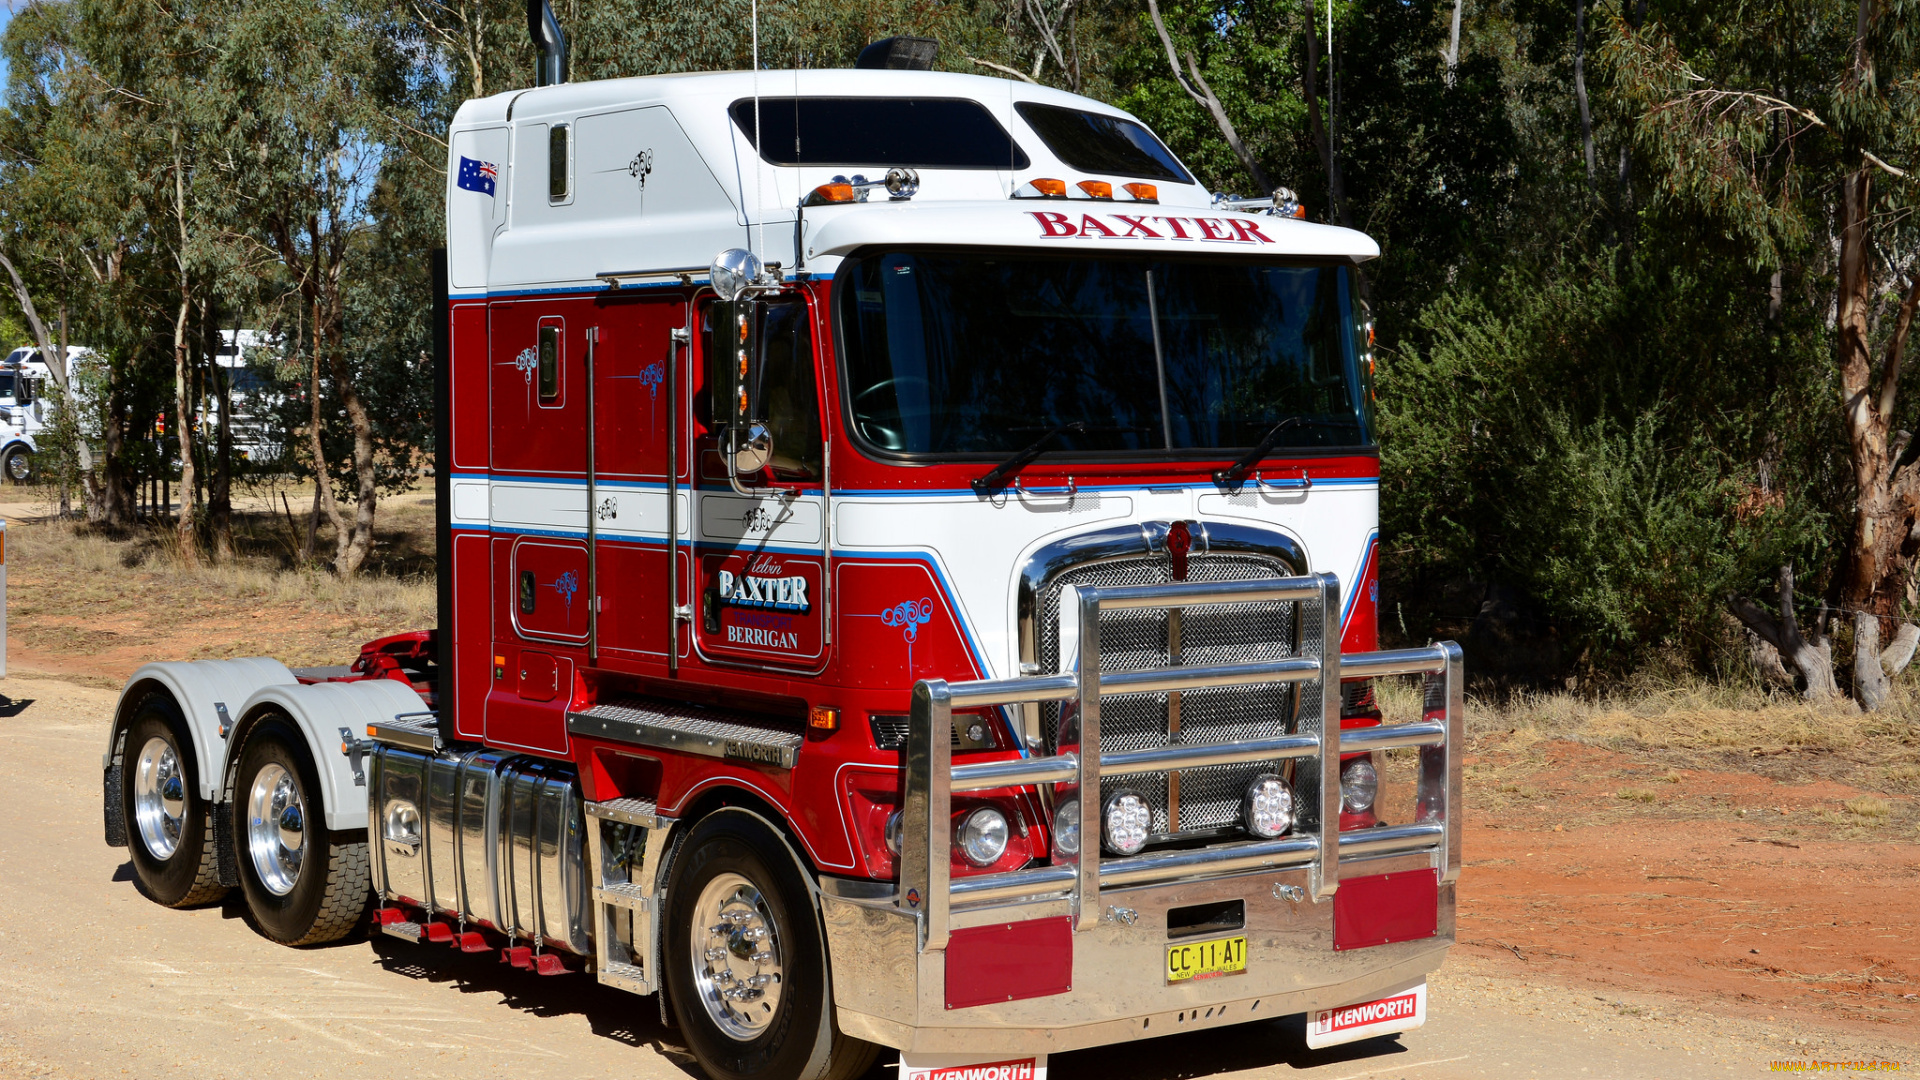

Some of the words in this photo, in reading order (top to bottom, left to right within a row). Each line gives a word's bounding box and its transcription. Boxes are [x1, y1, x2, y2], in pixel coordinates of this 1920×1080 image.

[1024, 211, 1276, 245] BAXTER
[742, 554, 782, 574] Kelvin
[719, 570, 809, 611] BAXTER
[733, 611, 793, 630] TRANSPORT
[727, 625, 798, 649] BERRIGAN
[724, 740, 780, 763] KENWORTH
[1176, 971, 1190, 979] NEW
[1217, 963, 1237, 972] WALES
[1193, 971, 1223, 981] KENWORTH
[1334, 998, 1413, 1027] KENWORTH
